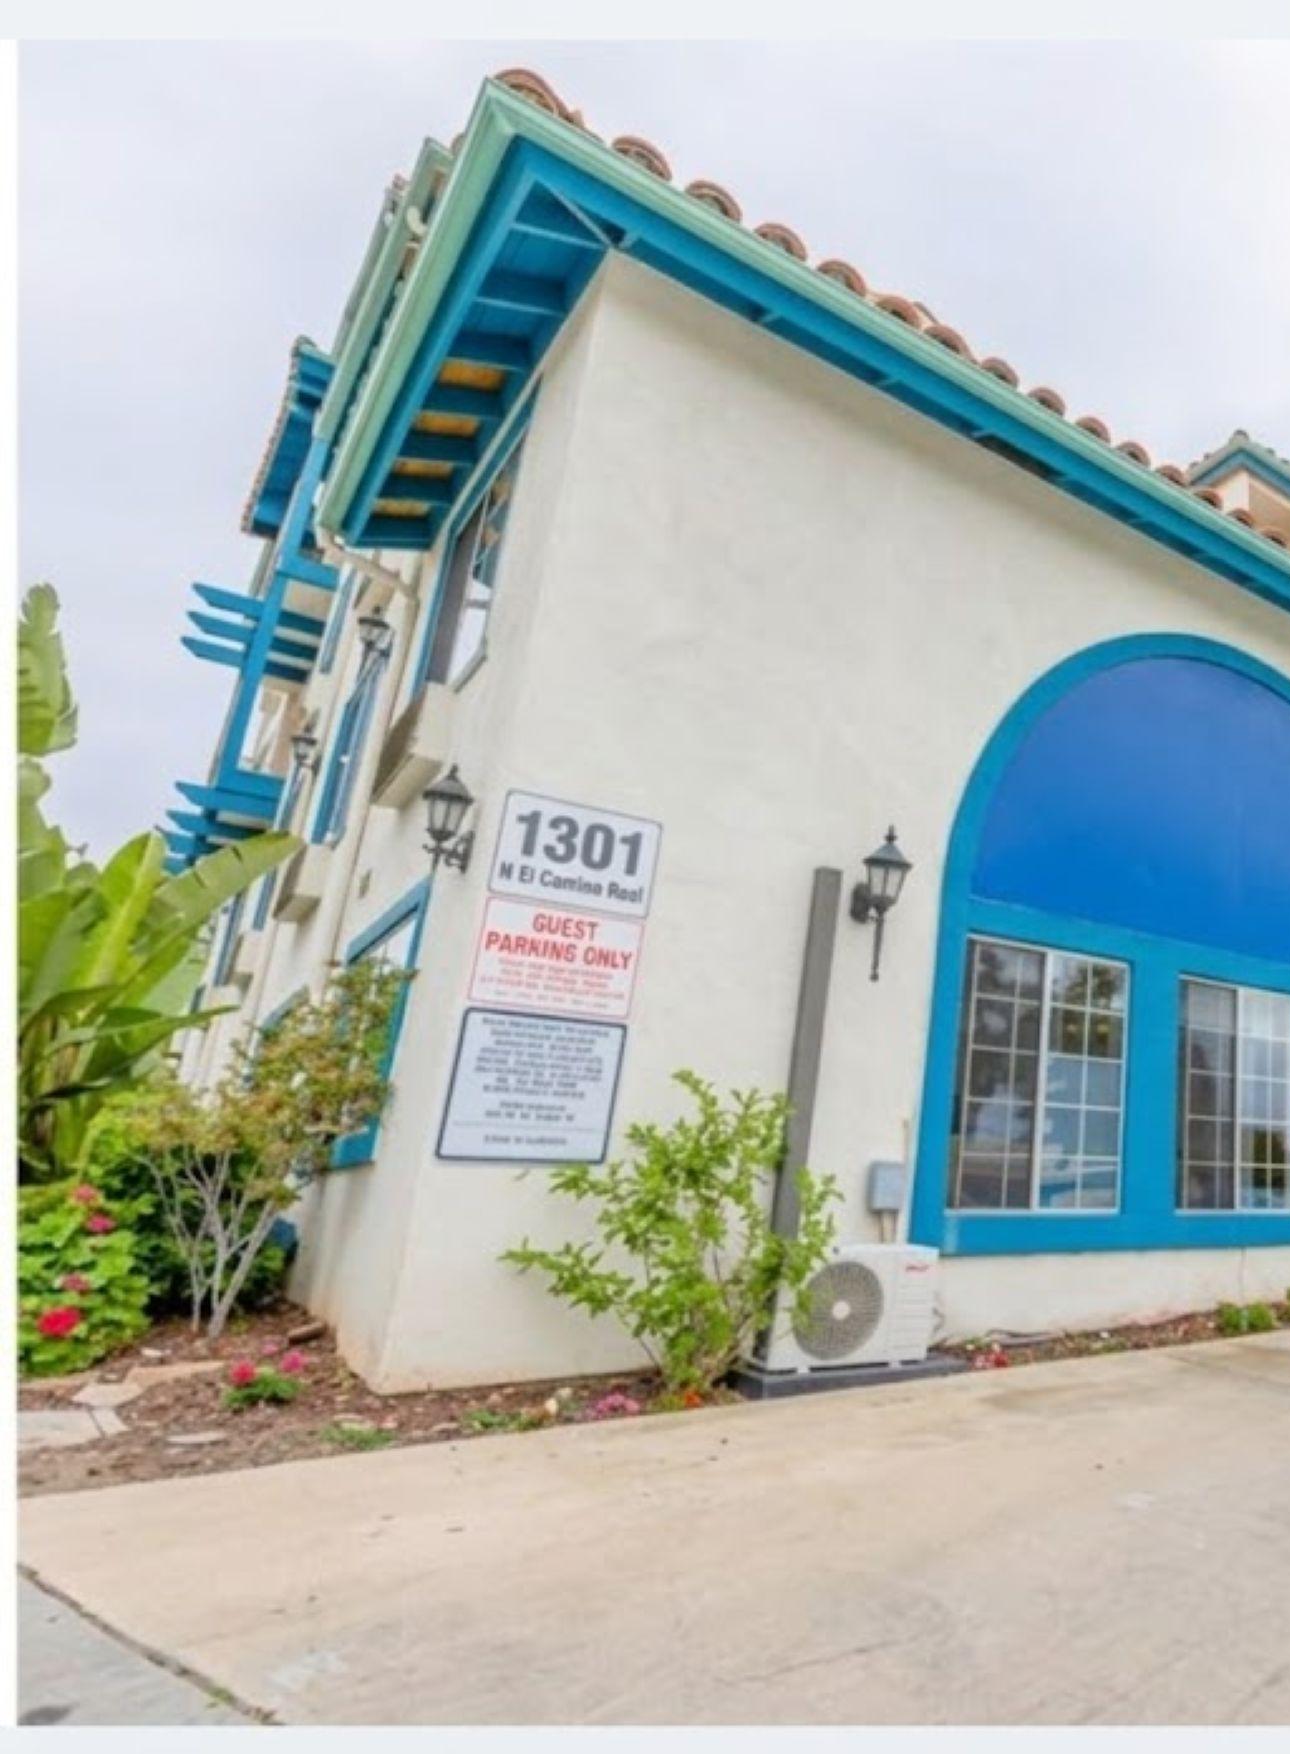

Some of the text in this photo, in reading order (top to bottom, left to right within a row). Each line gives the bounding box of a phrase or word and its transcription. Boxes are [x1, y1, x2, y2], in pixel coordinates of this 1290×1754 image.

[516, 810, 642, 877] 1301
[499, 861, 513, 880] N
[518, 865, 535, 884] El
[539, 869, 602, 895] Camino
[533, 913, 598, 940] GUEST
[583, 946, 632, 970] ONLY
